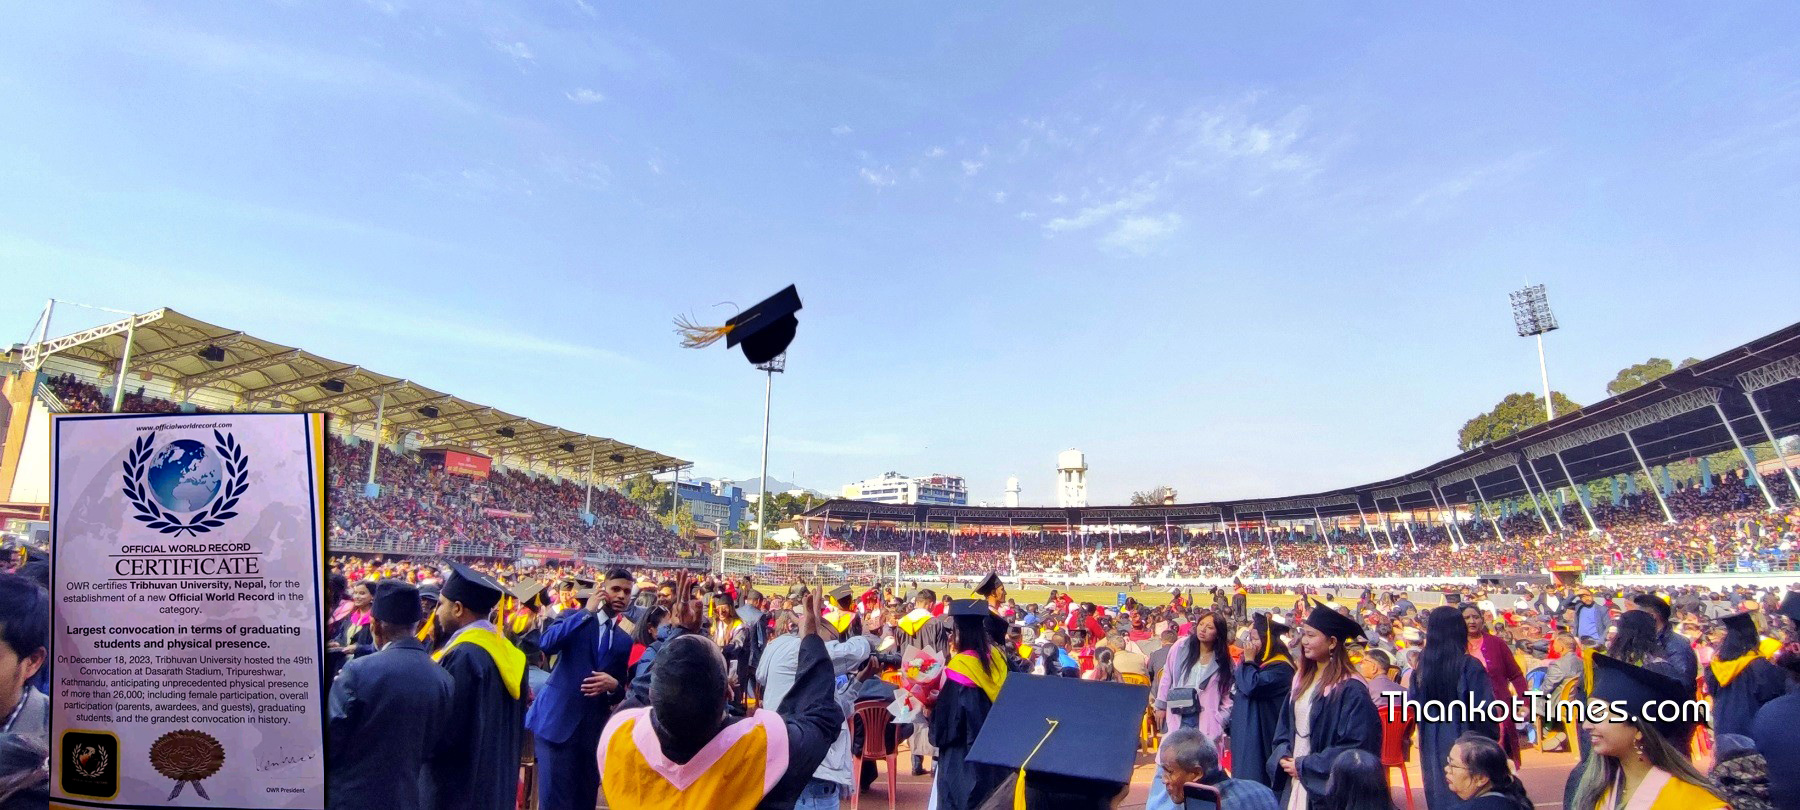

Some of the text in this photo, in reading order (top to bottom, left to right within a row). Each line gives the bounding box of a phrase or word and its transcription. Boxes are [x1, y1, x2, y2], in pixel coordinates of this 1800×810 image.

[136, 422, 232, 431] www.officialworldrecord.com
[121, 543, 251, 554] OFFICIAL WORLD RECORD
[116, 557, 259, 576] CERTIFICATE
[67, 580, 300, 591] OWR certifies Tribhuvan University, Nepal, for the
[63, 594, 125, 602] establishment
[127, 593, 137, 602] of
[169, 593, 203, 601] Official
[206, 593, 235, 601] World
[238, 592, 274, 601] Record
[278, 592, 286, 600] in
[288, 592, 304, 601] the
[159, 606, 202, 615] category.
[67, 625, 300, 636] Largest convocation in terms of graduating
[94, 639, 270, 650] students and physical presence.
[58, 655, 313, 666] On December 18, 2023, Tribhuvan University hosted the 49th
[80, 667, 132, 675] Convocation
[145, 667, 183, 675] Dasarath
[186, 667, 223, 676] Stadium,
[226, 667, 285, 677] Tripureshwar,
[61, 678, 308, 690] Kathmandu, anticipating unprecedented physical presence
[61, 689, 308, 701] of more than 26,000; including female participation, overall
[64, 702, 305, 714] participation (parents, awardees, and guests), graduating
[76, 714, 290, 726] students, and the grandest convocation in history.
